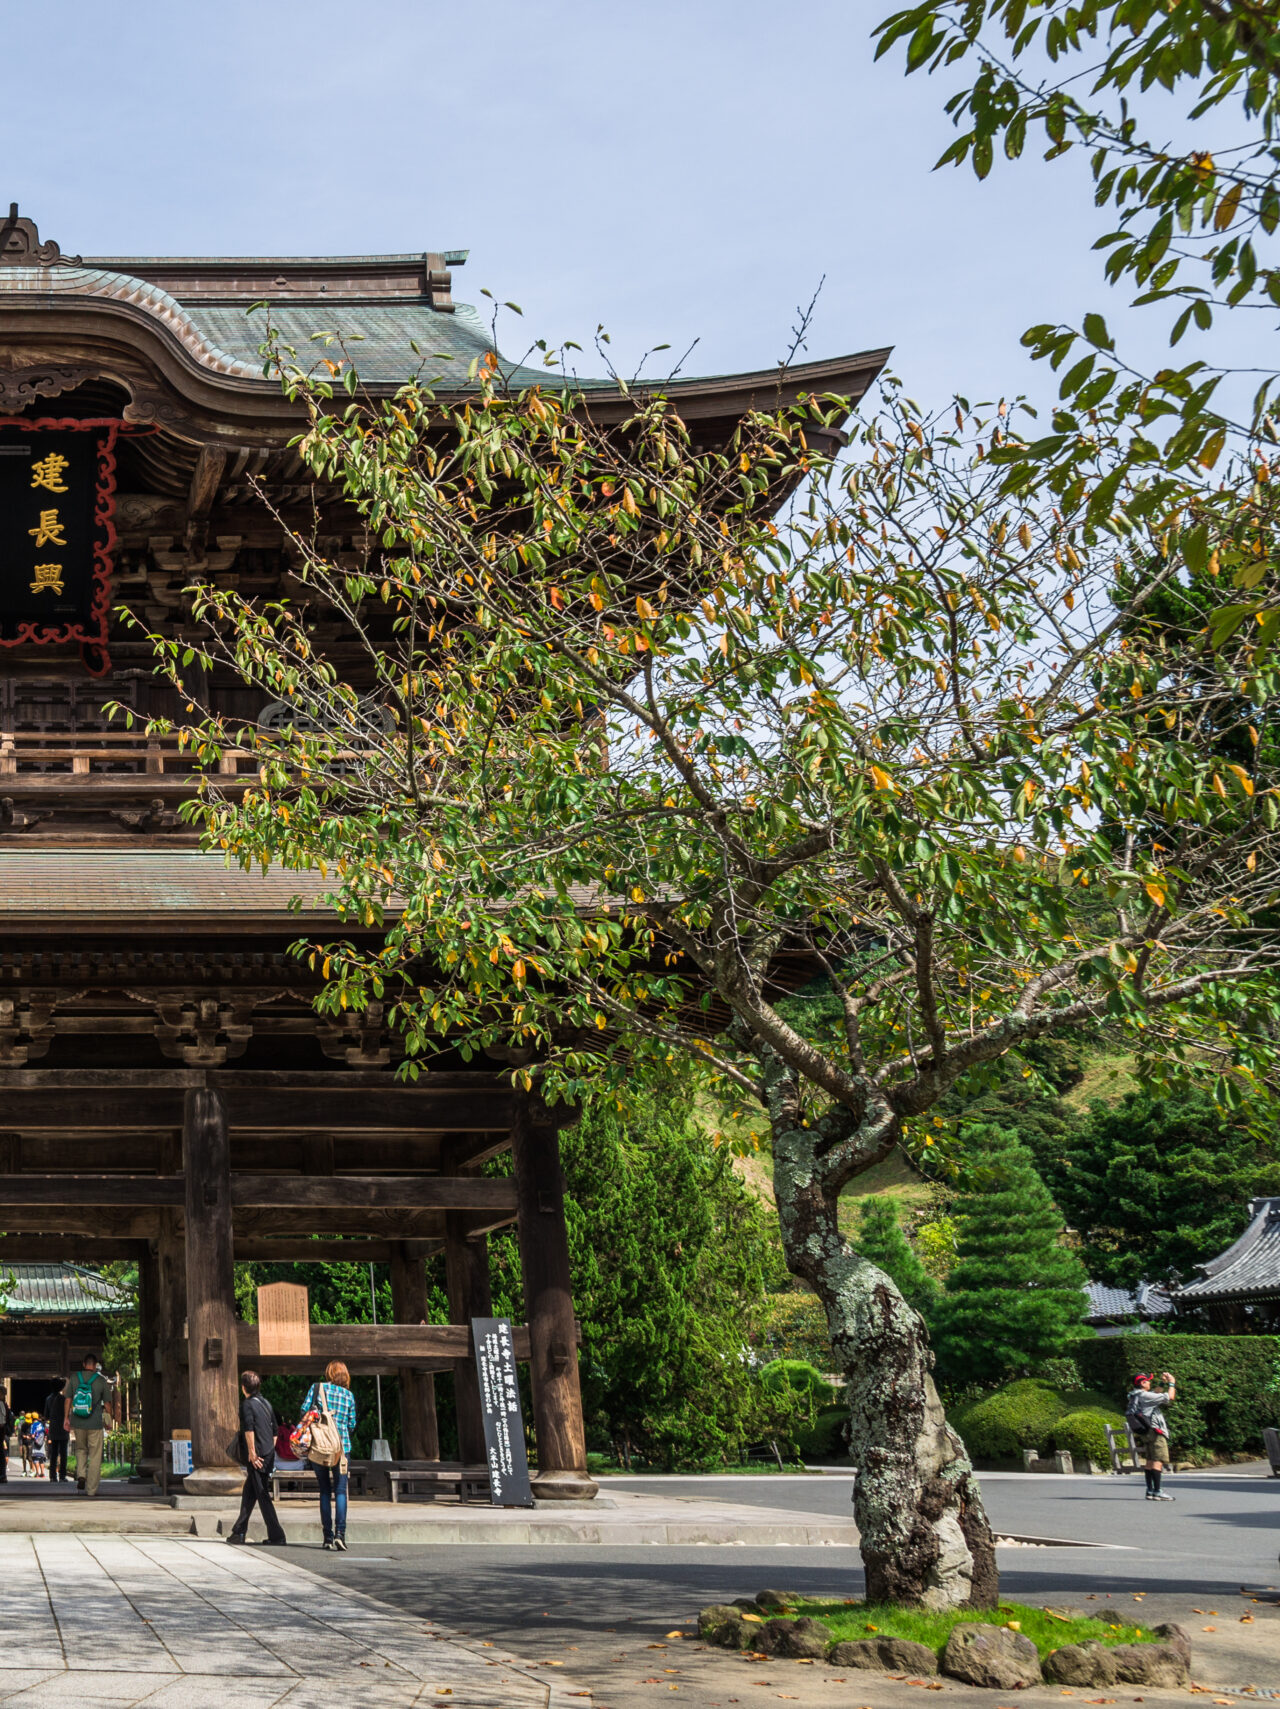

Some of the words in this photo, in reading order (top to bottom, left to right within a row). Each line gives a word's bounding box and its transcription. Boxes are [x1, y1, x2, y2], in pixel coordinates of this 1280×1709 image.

[28, 452, 70, 596] 建長興
[498, 1323, 518, 1412] 建長寺土曜法話
